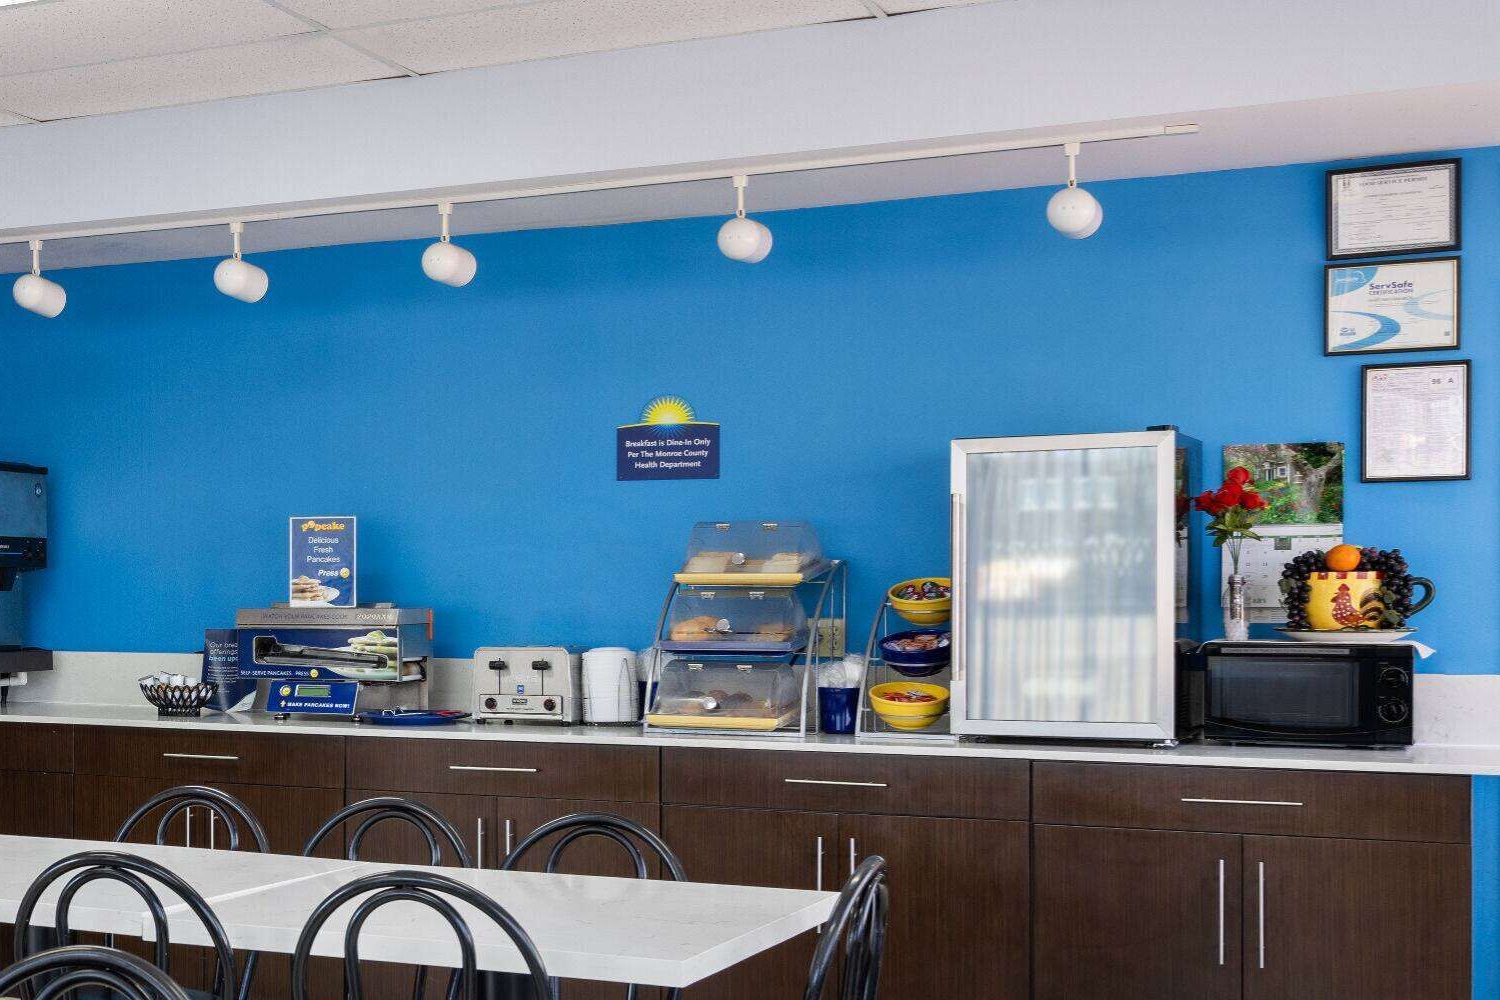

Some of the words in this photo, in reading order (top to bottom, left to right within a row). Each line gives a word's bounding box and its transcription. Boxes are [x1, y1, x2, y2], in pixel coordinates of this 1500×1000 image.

[1369, 280, 1414, 291] ServSafe
[693, 437, 711, 446] Only
[683, 449, 709, 458] County
[634, 461, 658, 469] Health
[660, 460, 701, 469] Department
[308, 536, 339, 544] Delicious
[313, 546, 334, 554] Fresh
[306, 555, 341, 563] Pancakes
[317, 569, 339, 577] Press
